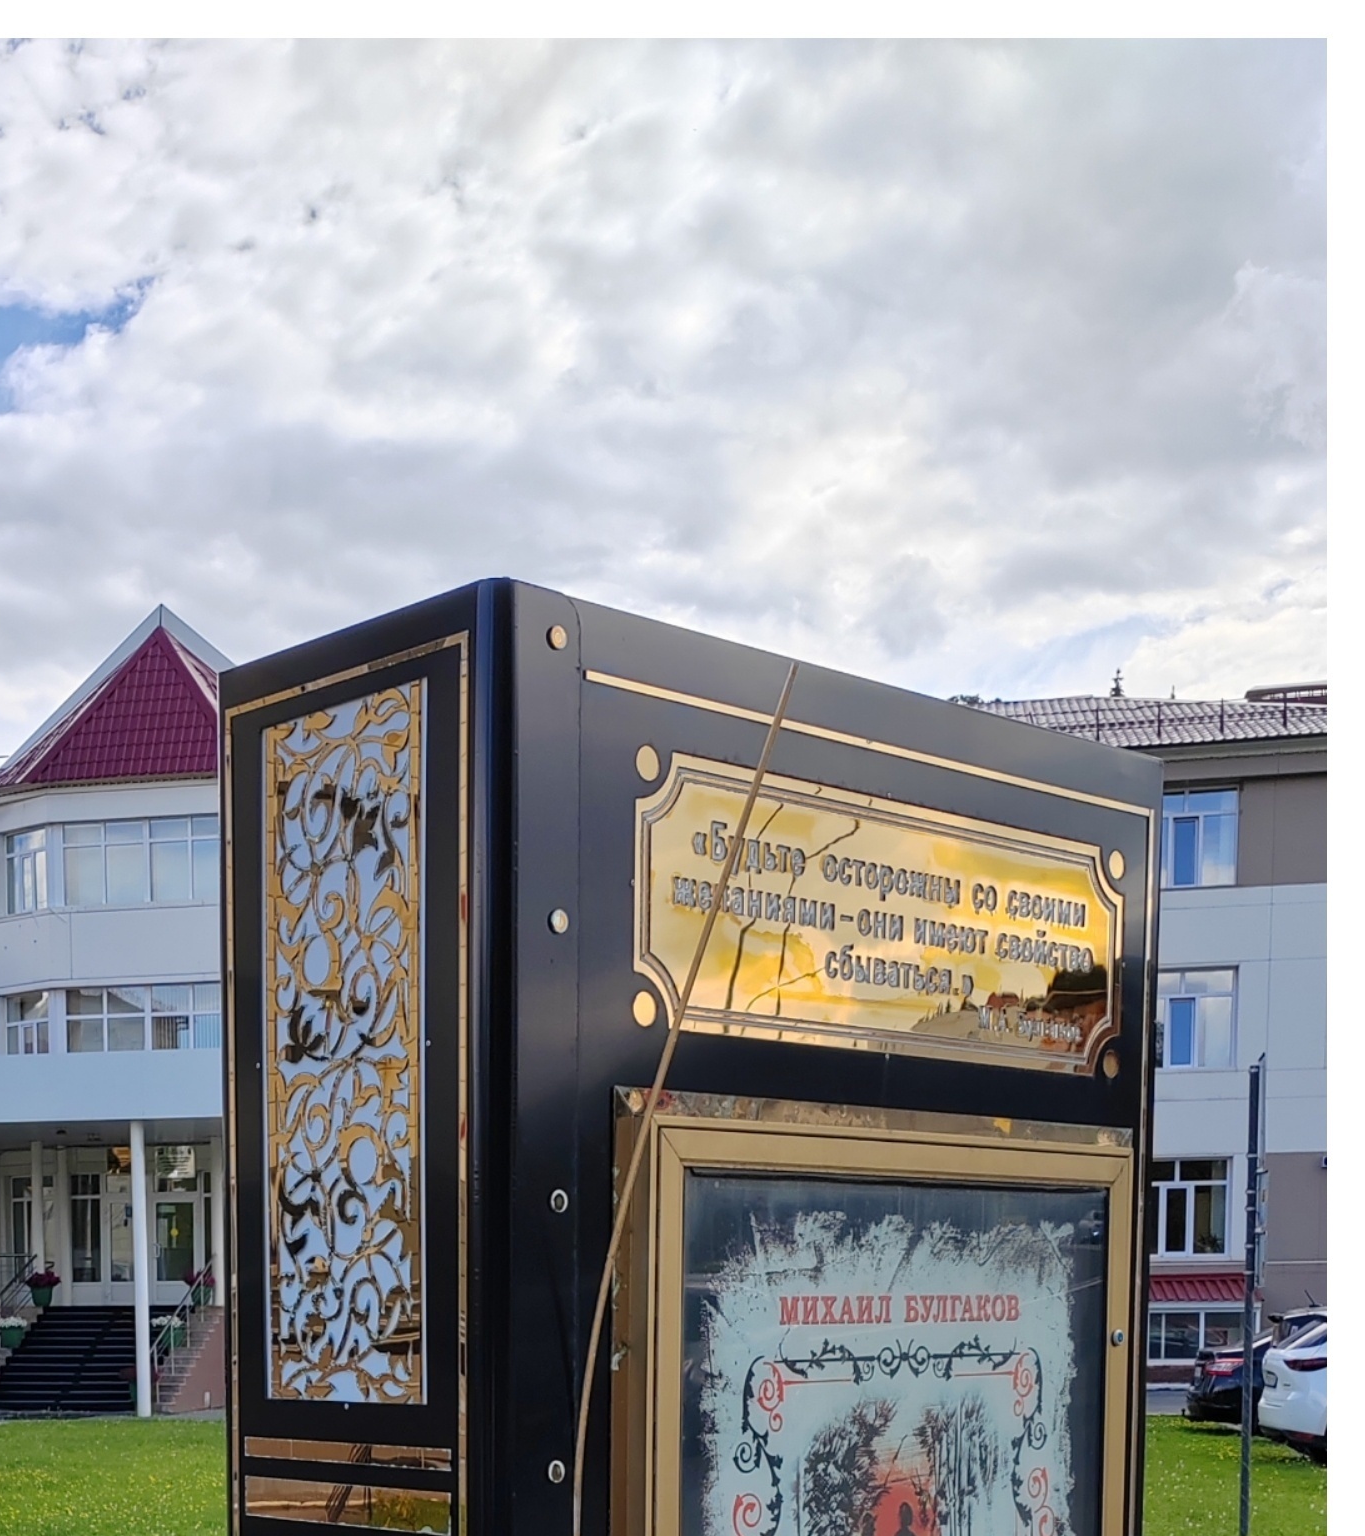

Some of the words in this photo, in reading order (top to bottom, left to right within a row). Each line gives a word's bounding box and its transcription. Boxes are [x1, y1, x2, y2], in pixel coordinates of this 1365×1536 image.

[822, 853, 961, 905] осторожны
[971, 883, 998, 912] со
[1007, 889, 1086, 928] своими
[914, 917, 989, 955] имеют
[997, 929, 1094, 973] свойство
[778, 1295, 892, 1326] МИХАИЛ
[904, 1293, 1020, 1323] БУЛГАКОВ
